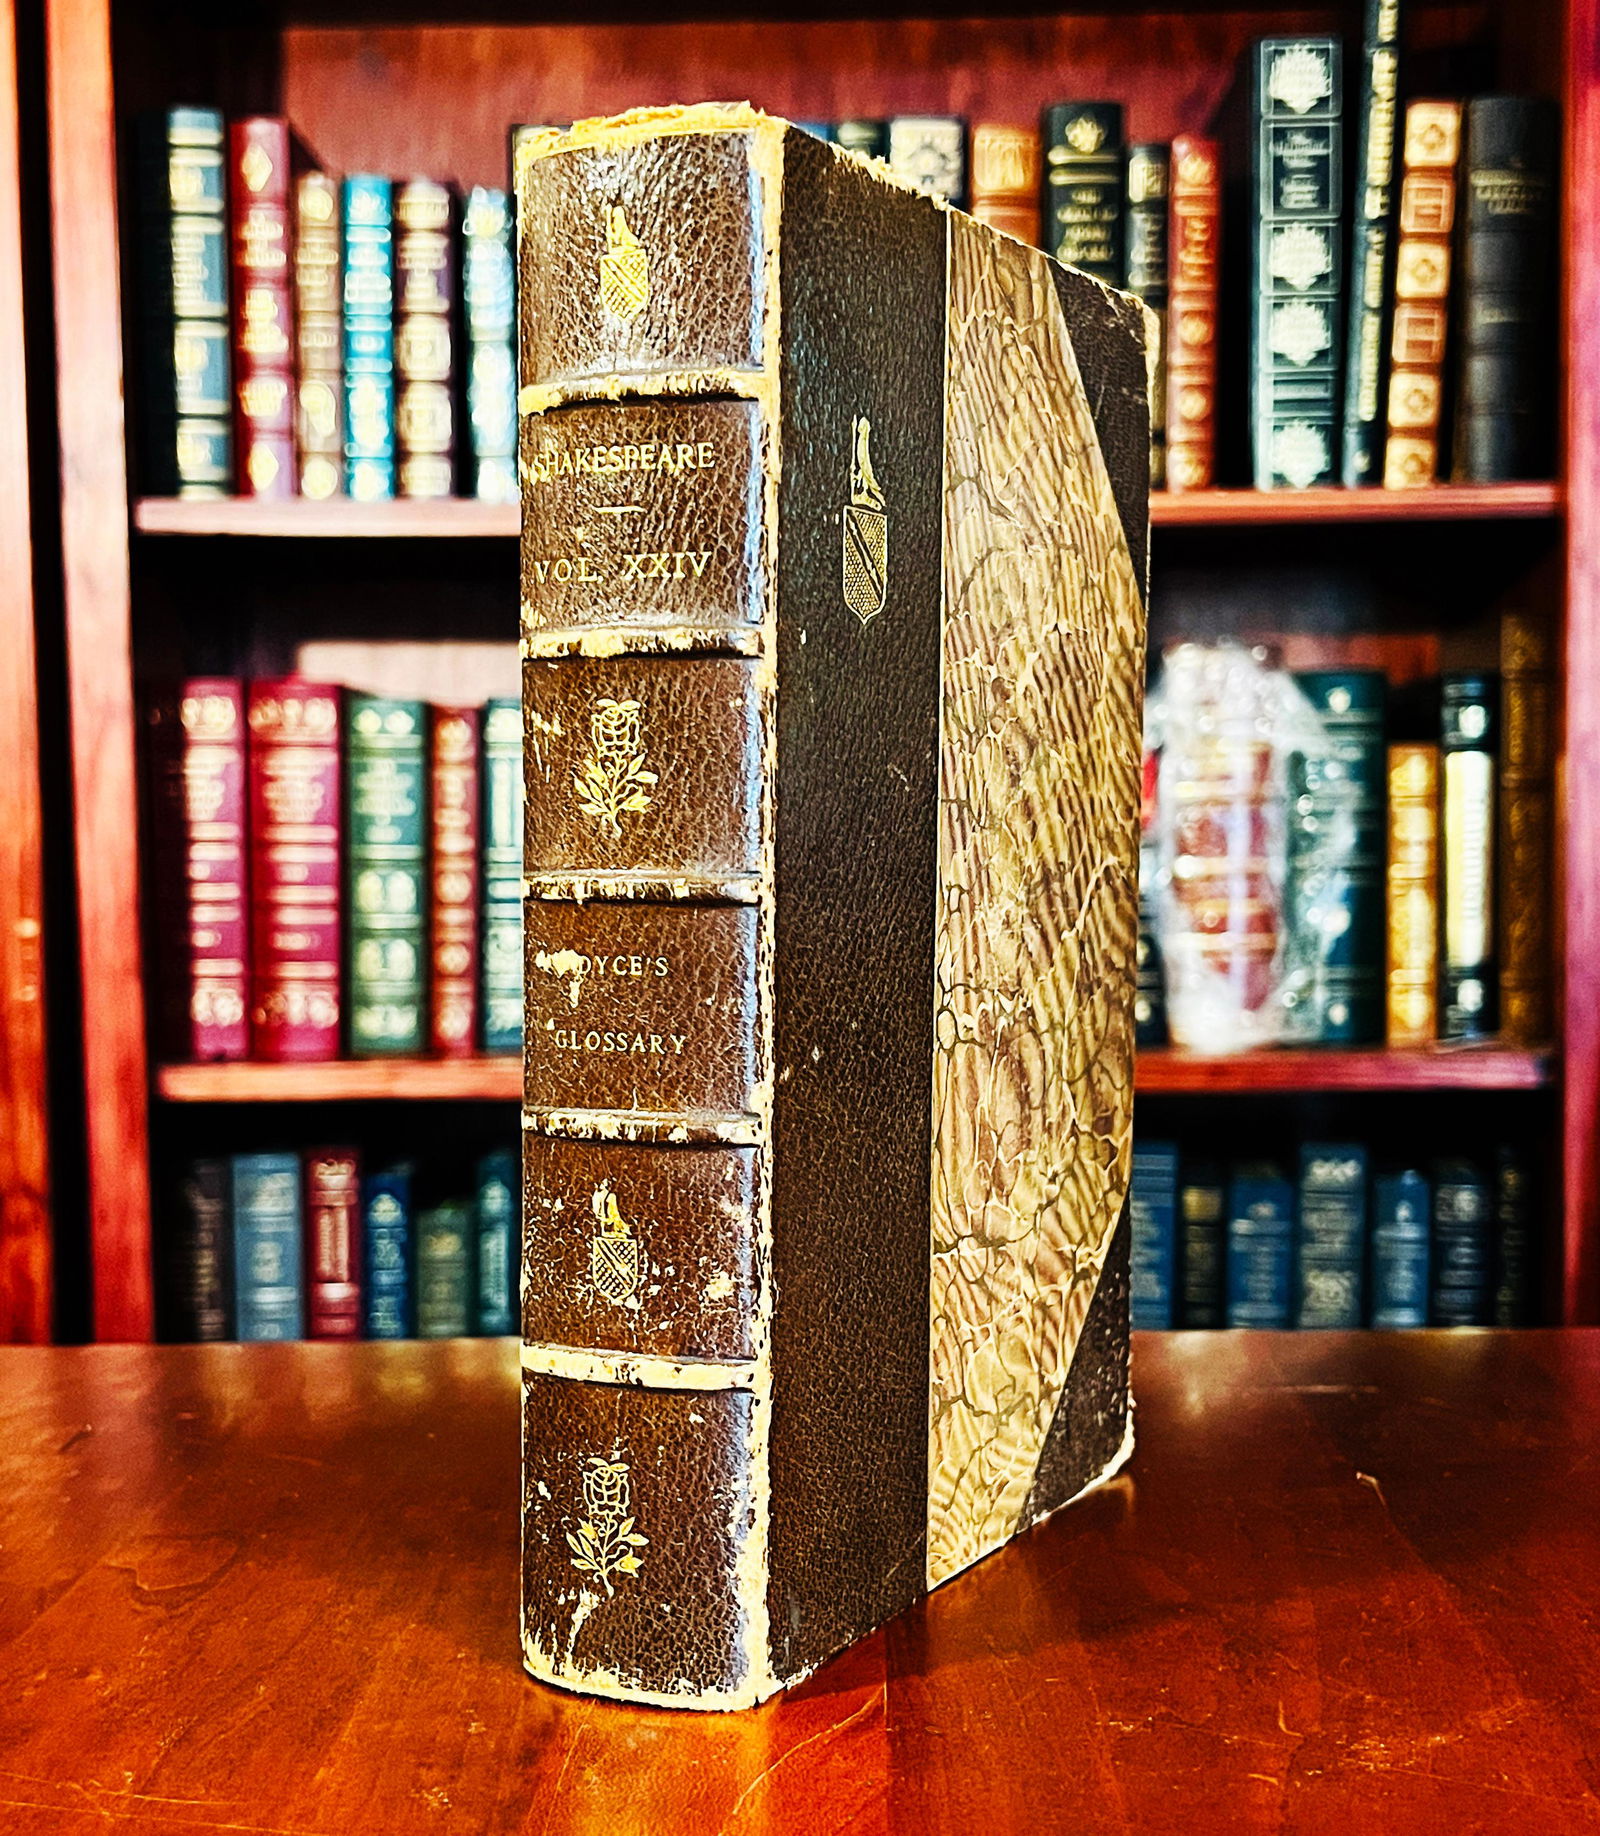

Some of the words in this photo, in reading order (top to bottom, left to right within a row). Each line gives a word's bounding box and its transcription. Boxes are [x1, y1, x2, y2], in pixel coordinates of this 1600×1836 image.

[534, 442, 716, 477] SHAKESPEARE
[622, 551, 712, 581] XXIV
[554, 1030, 687, 1055] GLOSSARY
